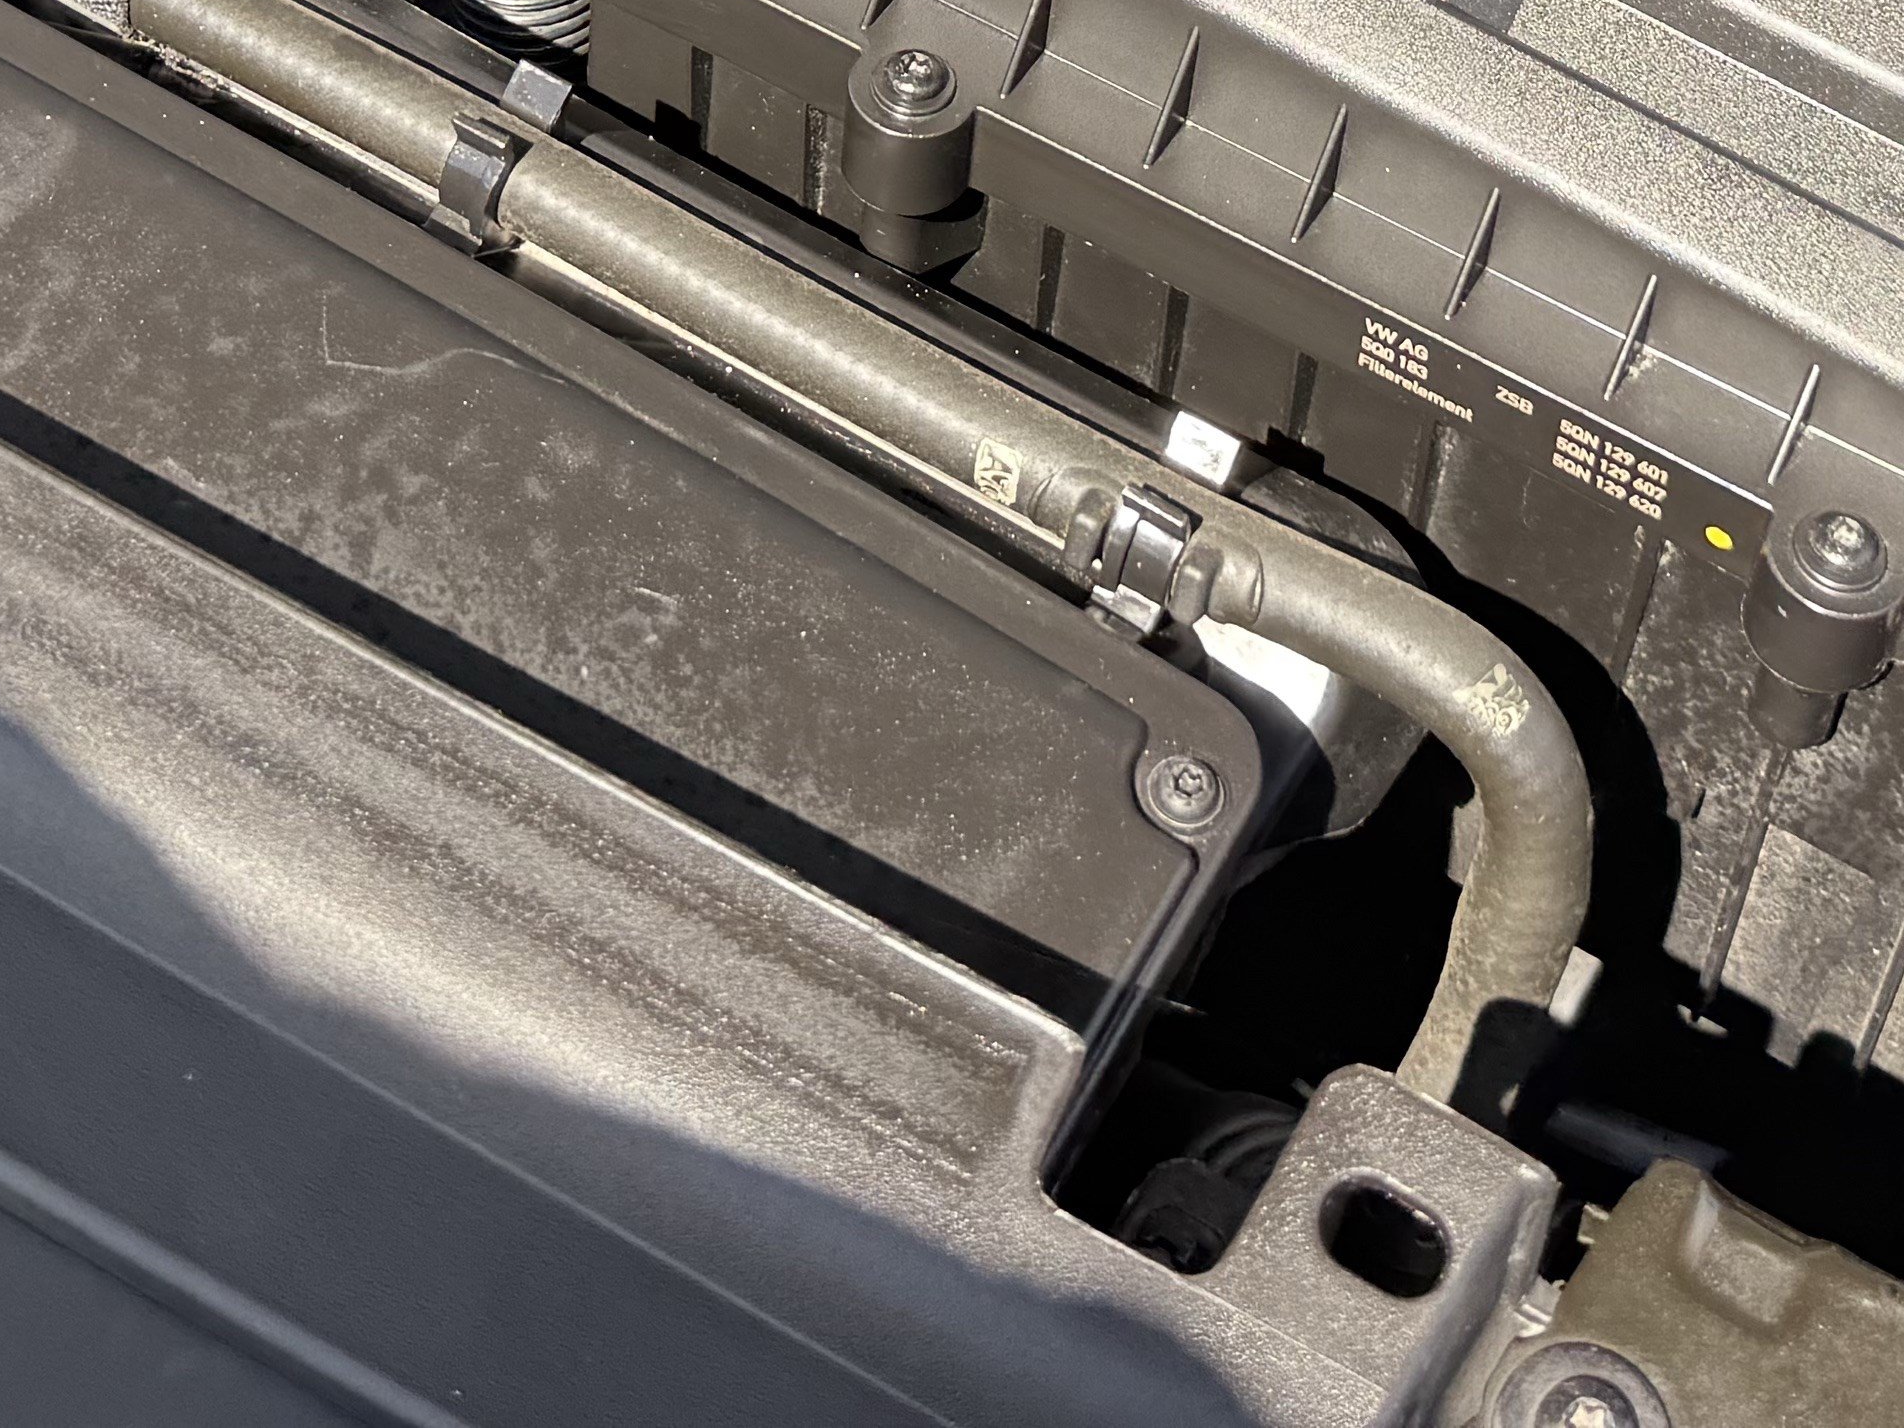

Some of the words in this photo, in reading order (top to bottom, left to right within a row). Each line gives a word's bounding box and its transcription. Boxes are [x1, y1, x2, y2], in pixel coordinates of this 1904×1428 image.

[1365, 317, 1398, 345] VW
[1398, 338, 1429, 362] AG
[1358, 352, 1473, 423] Filterelement
[1399, 354, 1428, 380] 183
[1495, 385, 1534, 415] ZSB
[1600, 458, 1631, 483] 129
[1632, 477, 1667, 501] 607
[1604, 441, 1636, 466] 129
[1637, 460, 1669, 485] 601
[1596, 475, 1627, 500] 129
[1628, 494, 1662, 520] 620
